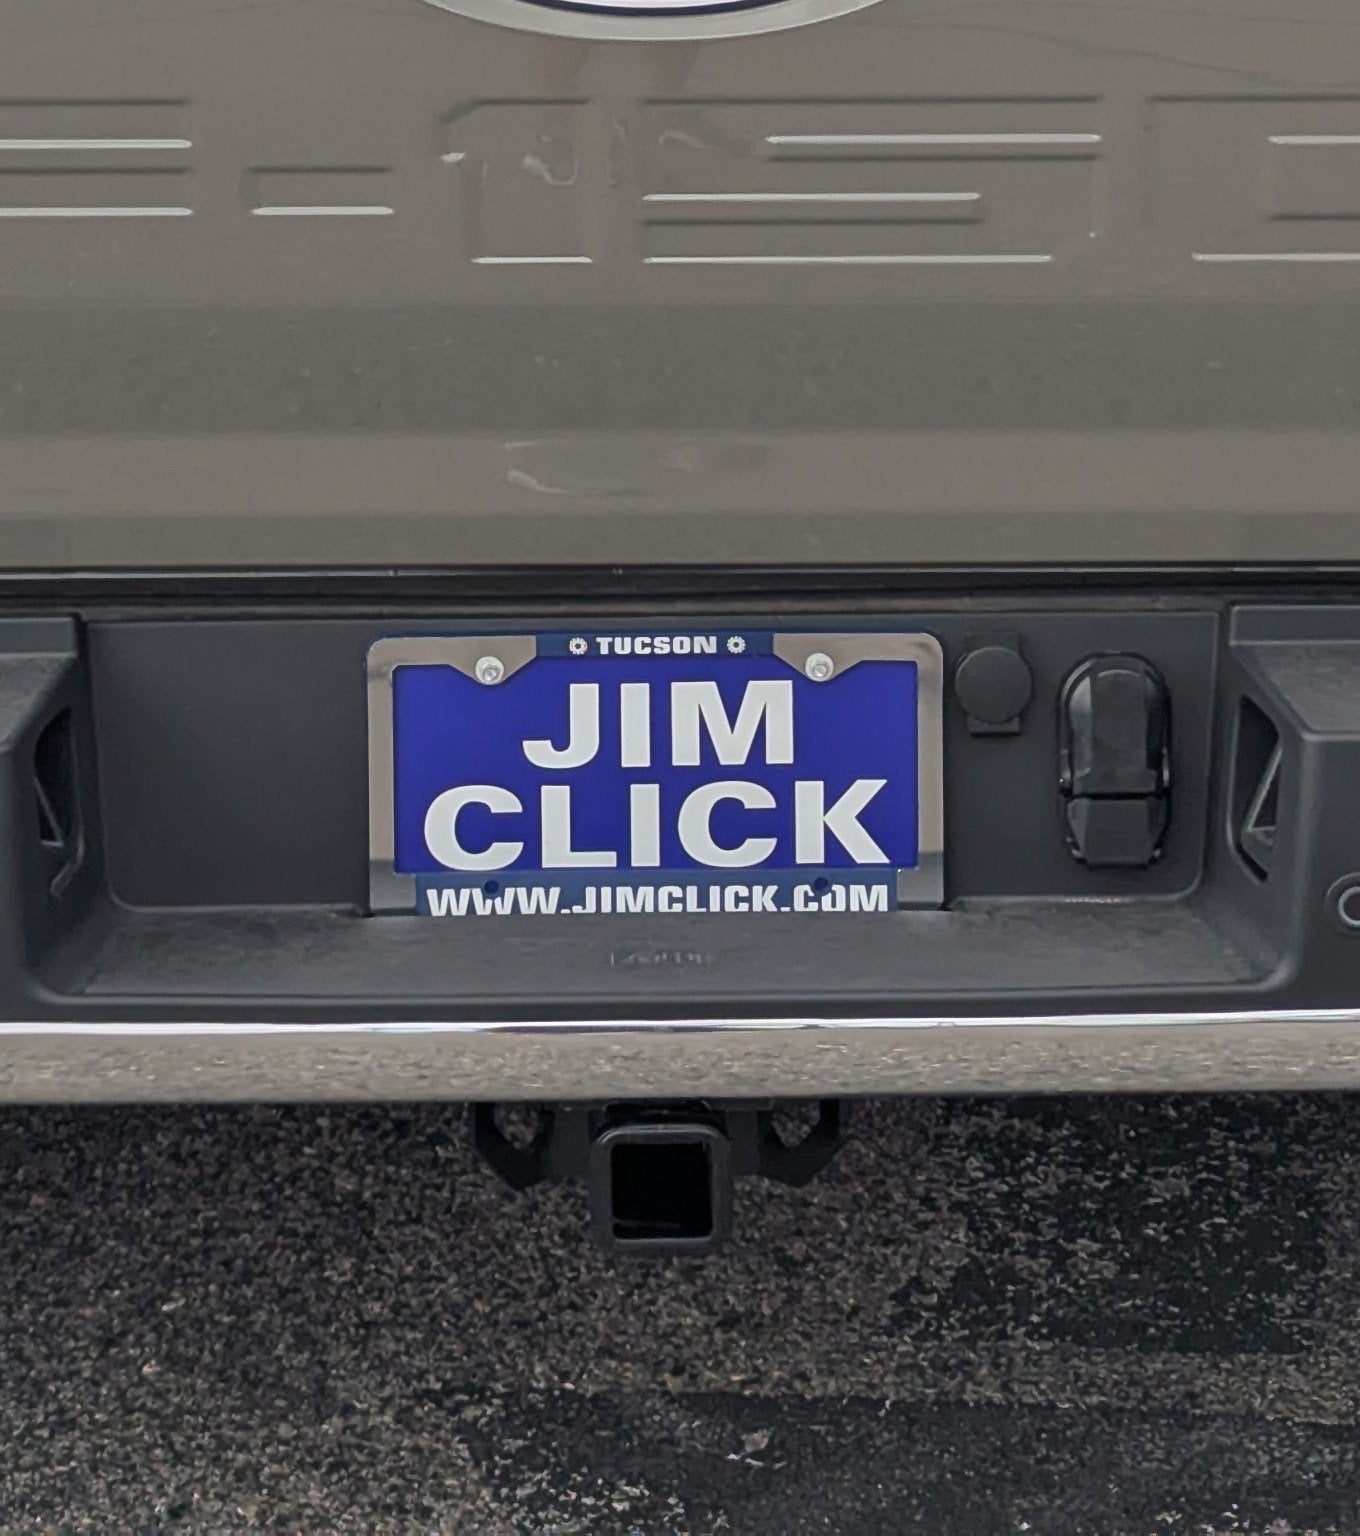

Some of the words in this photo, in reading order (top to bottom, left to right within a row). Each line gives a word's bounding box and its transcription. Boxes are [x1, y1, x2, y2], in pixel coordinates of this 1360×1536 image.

[595, 635, 718, 656] TUCSON
[521, 679, 795, 770] JIM
[423, 778, 893, 871] CLICK
[425, 884, 890, 917] WWW.JIMCLICK.COM
